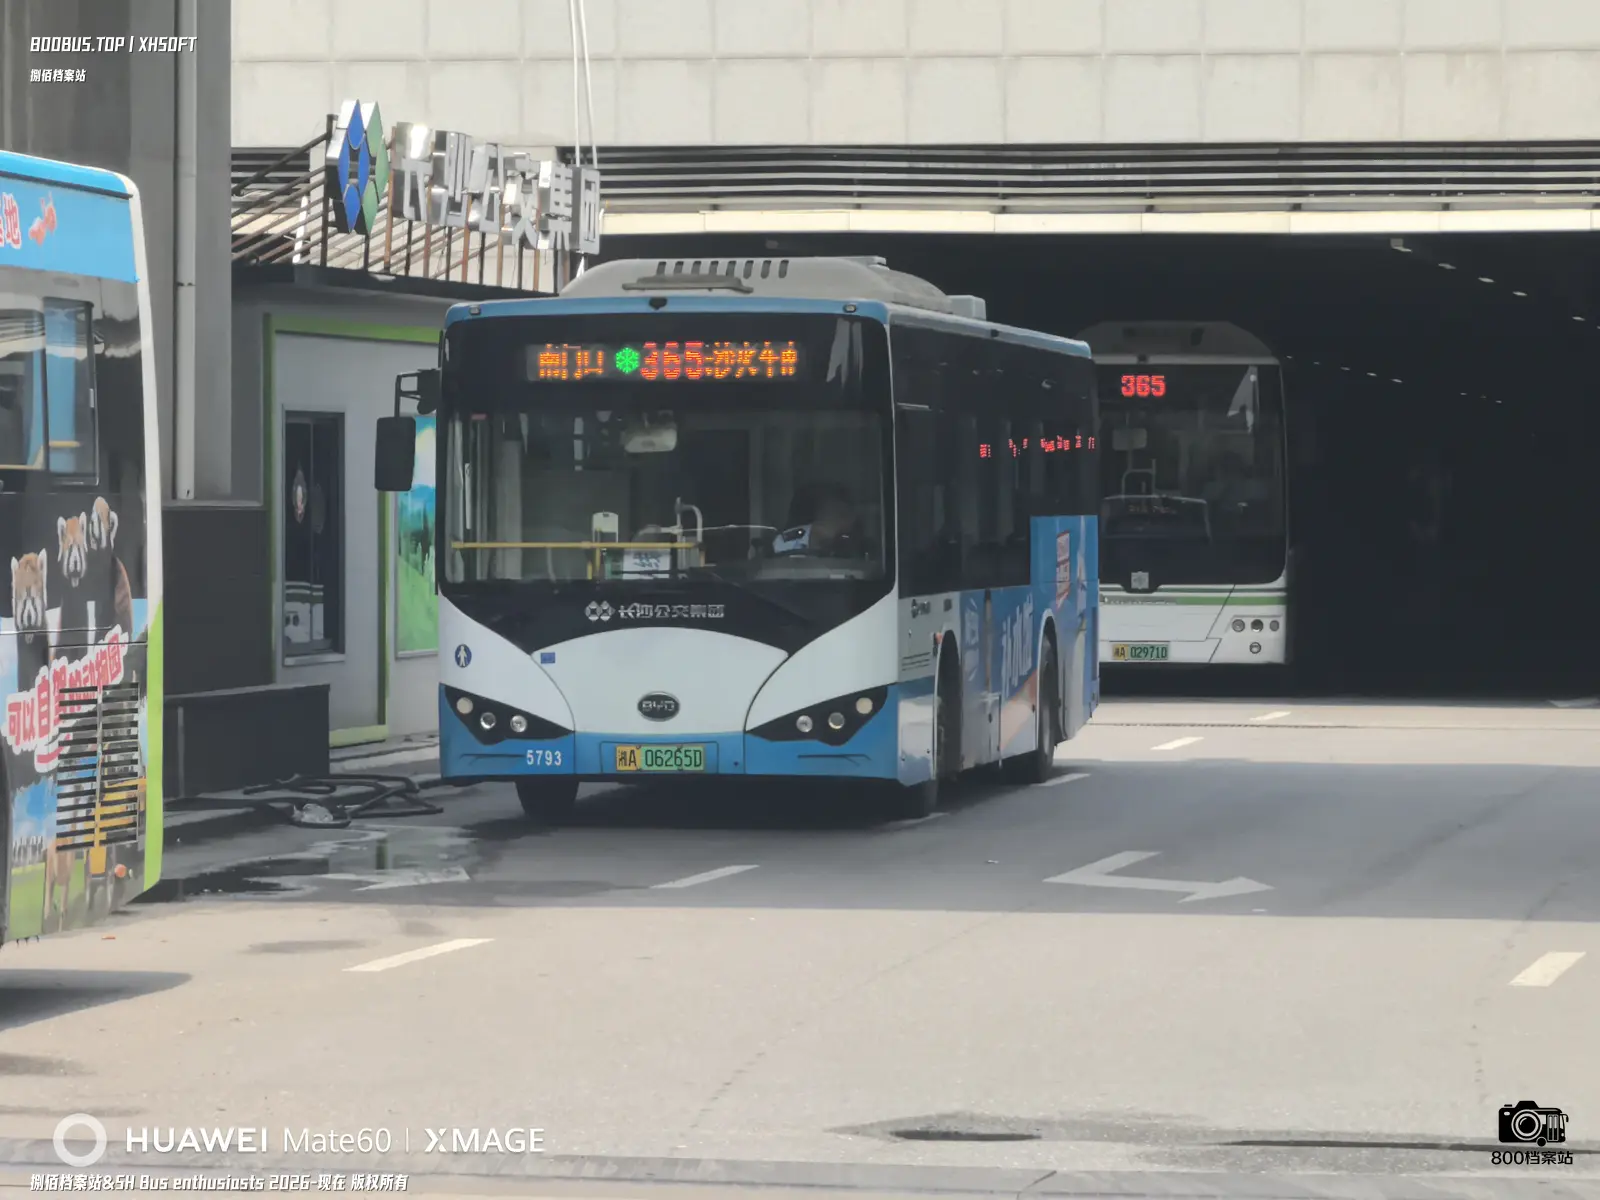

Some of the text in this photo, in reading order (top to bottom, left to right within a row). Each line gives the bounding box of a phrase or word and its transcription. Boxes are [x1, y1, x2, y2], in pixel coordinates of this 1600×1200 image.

[640, 341, 704, 380] 365
[1121, 375, 1166, 397] 365
[642, 700, 675, 711] BYD
[526, 749, 562, 766] 5793
[645, 749, 702, 767] 06265D
